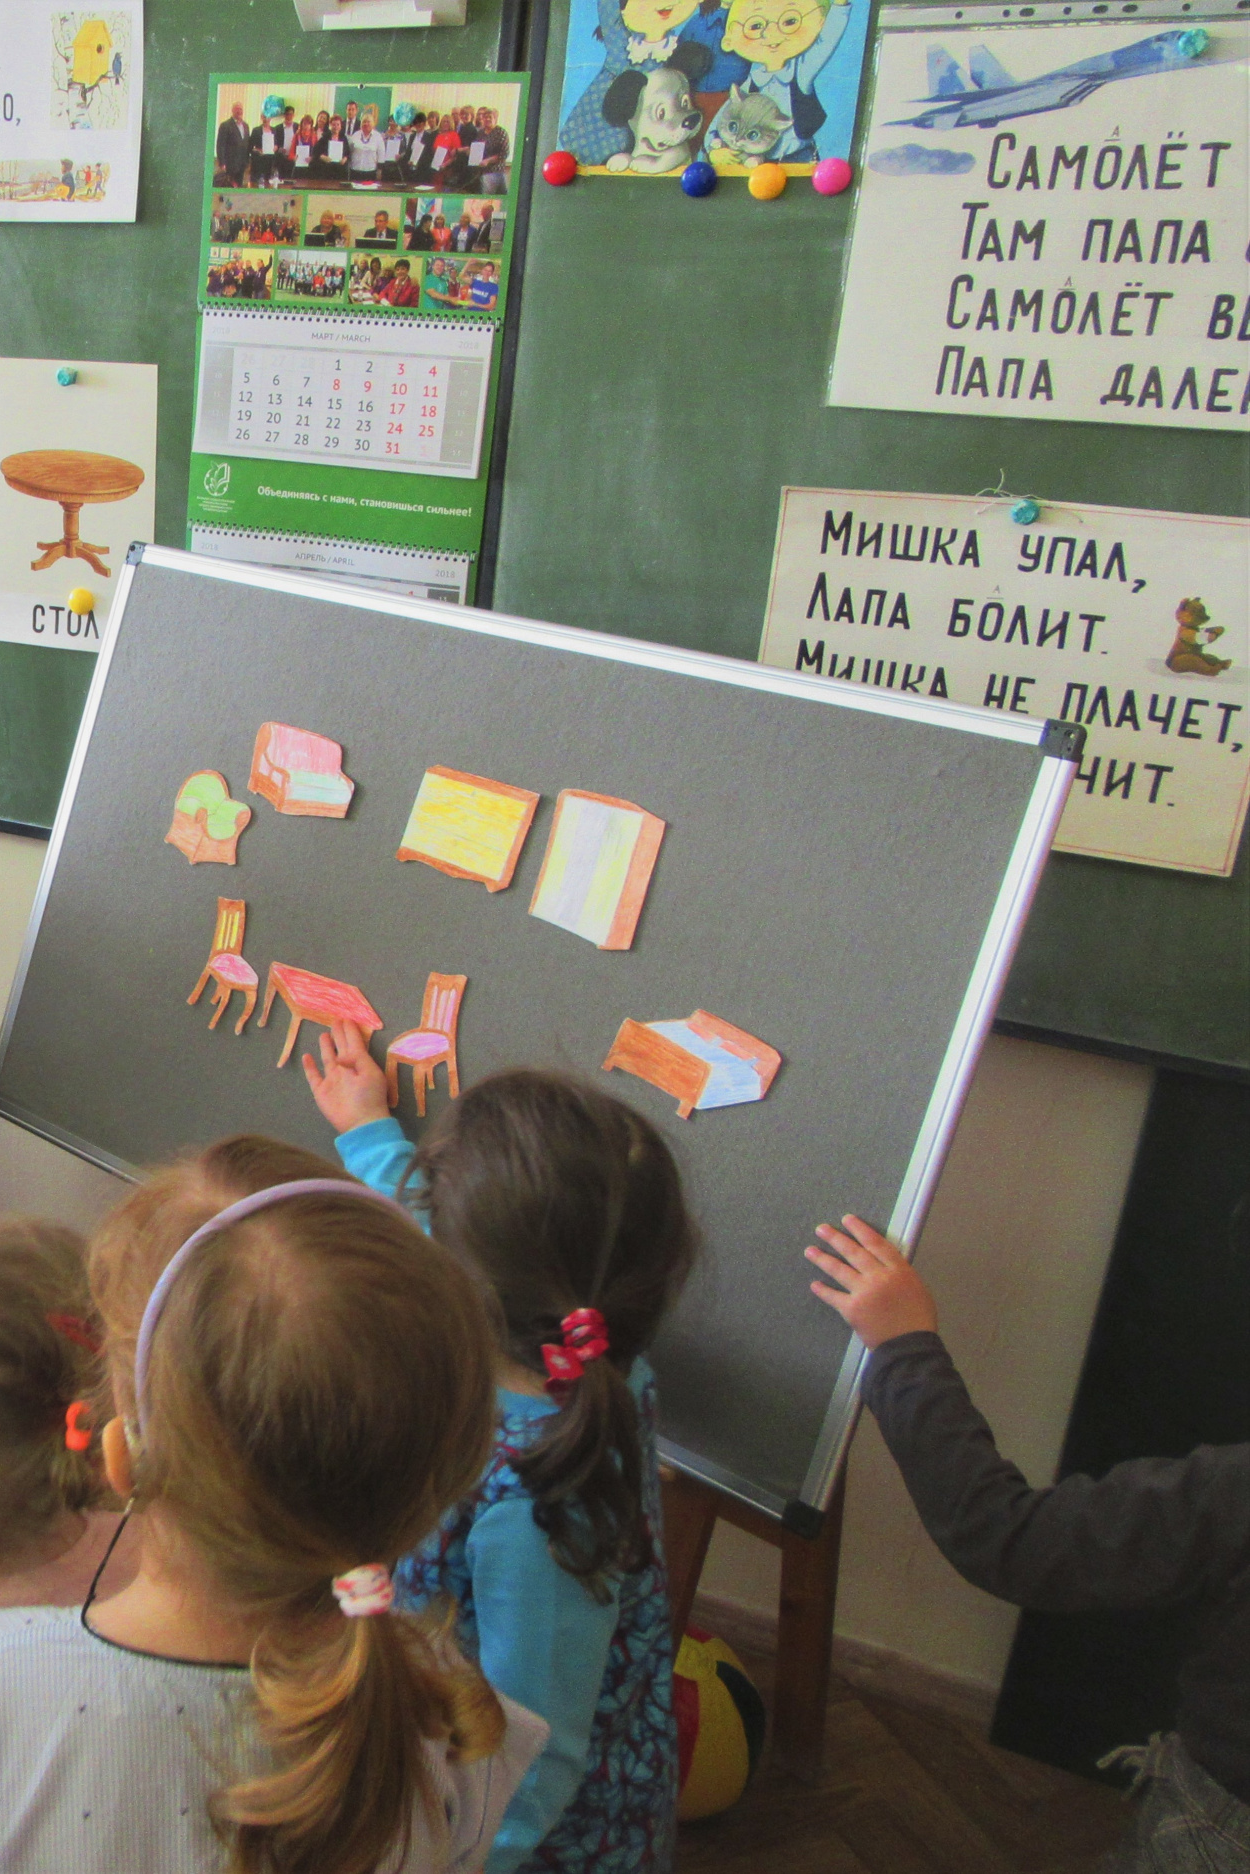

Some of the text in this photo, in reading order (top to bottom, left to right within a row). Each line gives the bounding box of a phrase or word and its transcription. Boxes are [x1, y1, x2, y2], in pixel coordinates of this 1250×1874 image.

[1082, 218, 1211, 264] ПАПА
[342, 334, 371, 342] MARCH
[335, 359, 342, 371] 1
[366, 361, 373, 373] 2
[397, 363, 405, 375] 3
[428, 366, 437, 377] 4
[243, 372, 250, 383] 5
[272, 375, 280, 386] 6
[303, 377, 310, 387] 7
[333, 379, 340, 390] 8
[364, 381, 371, 392] 9
[391, 383, 407, 395] 10
[423, 386, 438, 398] 11
[239, 391, 253, 403] 12
[268, 393, 283, 405] 13
[298, 395, 313, 407] 14
[327, 398, 342, 410] 15
[358, 401, 373, 413] 16
[390, 403, 405, 415] 17
[421, 405, 437, 417] 18
[237, 410, 252, 421] 19
[266, 412, 281, 424] 20
[296, 415, 310, 427] 21
[326, 417, 341, 429] 22
[356, 420, 371, 432] 23
[387, 422, 403, 434] 24
[418, 425, 434, 437] 25
[235, 428, 250, 440] 26
[265, 431, 280, 443] 27
[294, 433, 309, 445] 28
[324, 436, 339, 448] 29
[354, 439, 370, 451] 30
[385, 442, 400, 454] 31
[257, 485, 472, 517] Объединяясь с нами, становишься сильнее!
[295, 552, 326, 562] АПРЕЛЬ
[332, 556, 355, 566] APRIL
[1017, 534, 1147, 593] УПАЛ,
[435, 569, 455, 578] 2018
[32, 603, 100, 640] СТОЛ
[947, 598, 1108, 655] БОЛИТ.
[983, 673, 1036, 714] НЕ
[1059, 682, 1243, 753] ПЛАЧЕТ,
[1075, 754, 1175, 807] ЧИТ.
